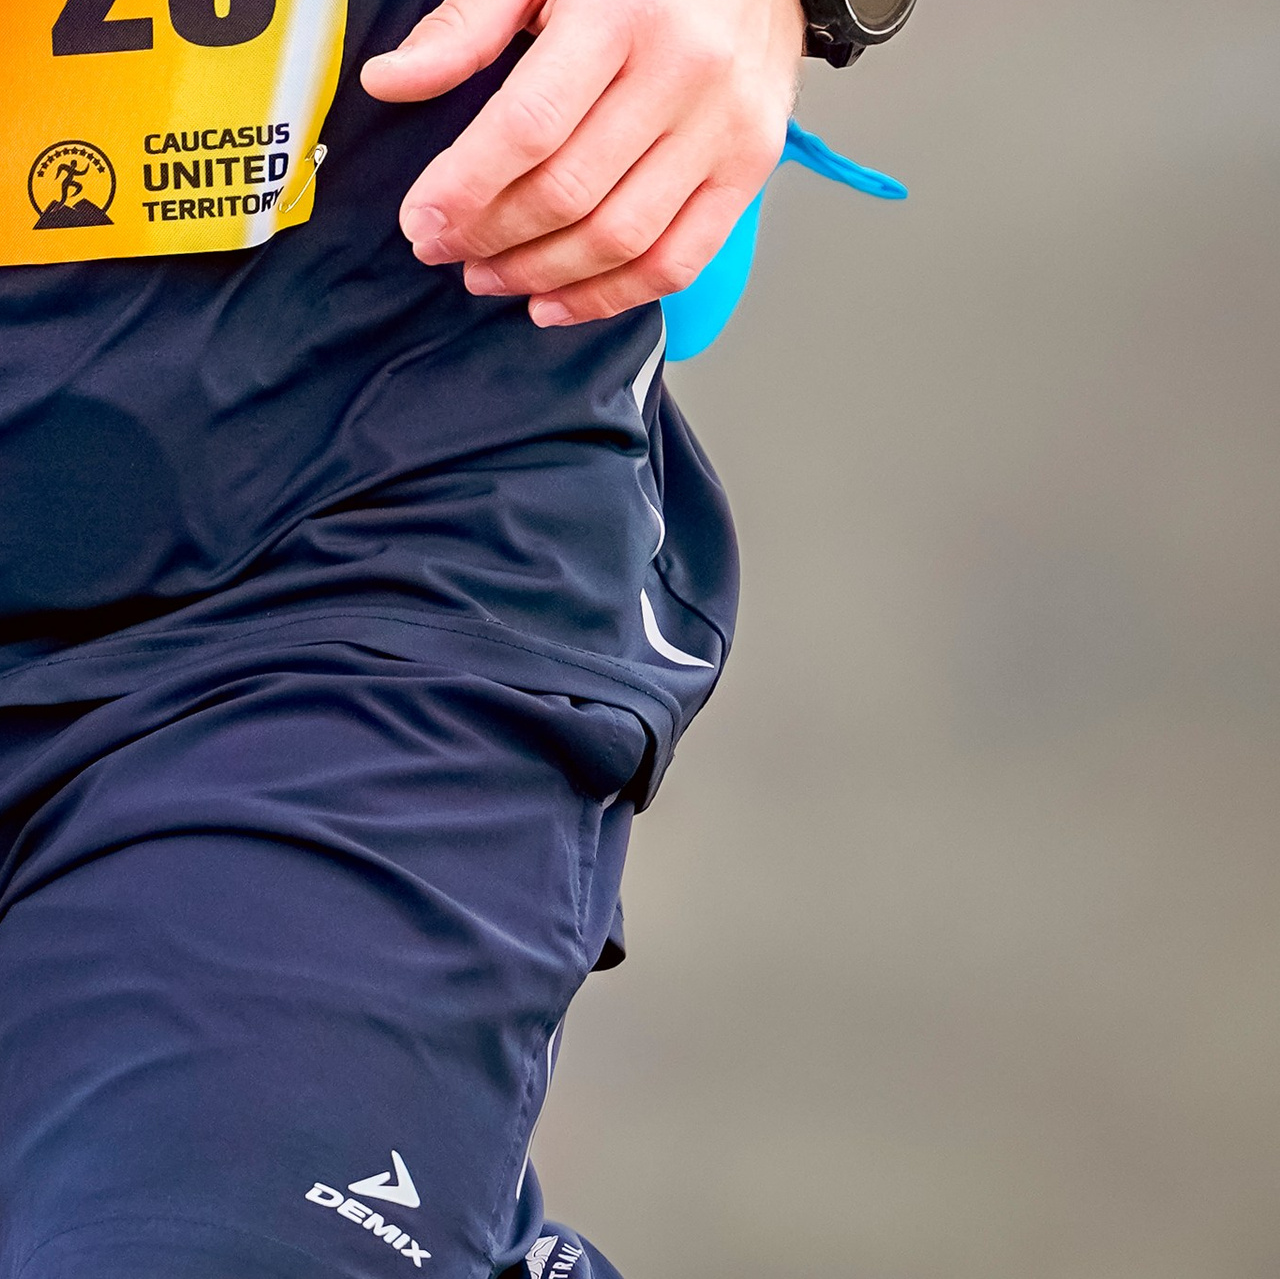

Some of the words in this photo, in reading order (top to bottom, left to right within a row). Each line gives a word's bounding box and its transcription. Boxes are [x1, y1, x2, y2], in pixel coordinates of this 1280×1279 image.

[144, 123, 290, 155] CAUCASUS
[143, 152, 289, 192] UNITED
[142, 186, 284, 222] TERRITORY
[304, 1182, 432, 1268] DEMIX
[548, 1242, 583, 1279] TRAIL
